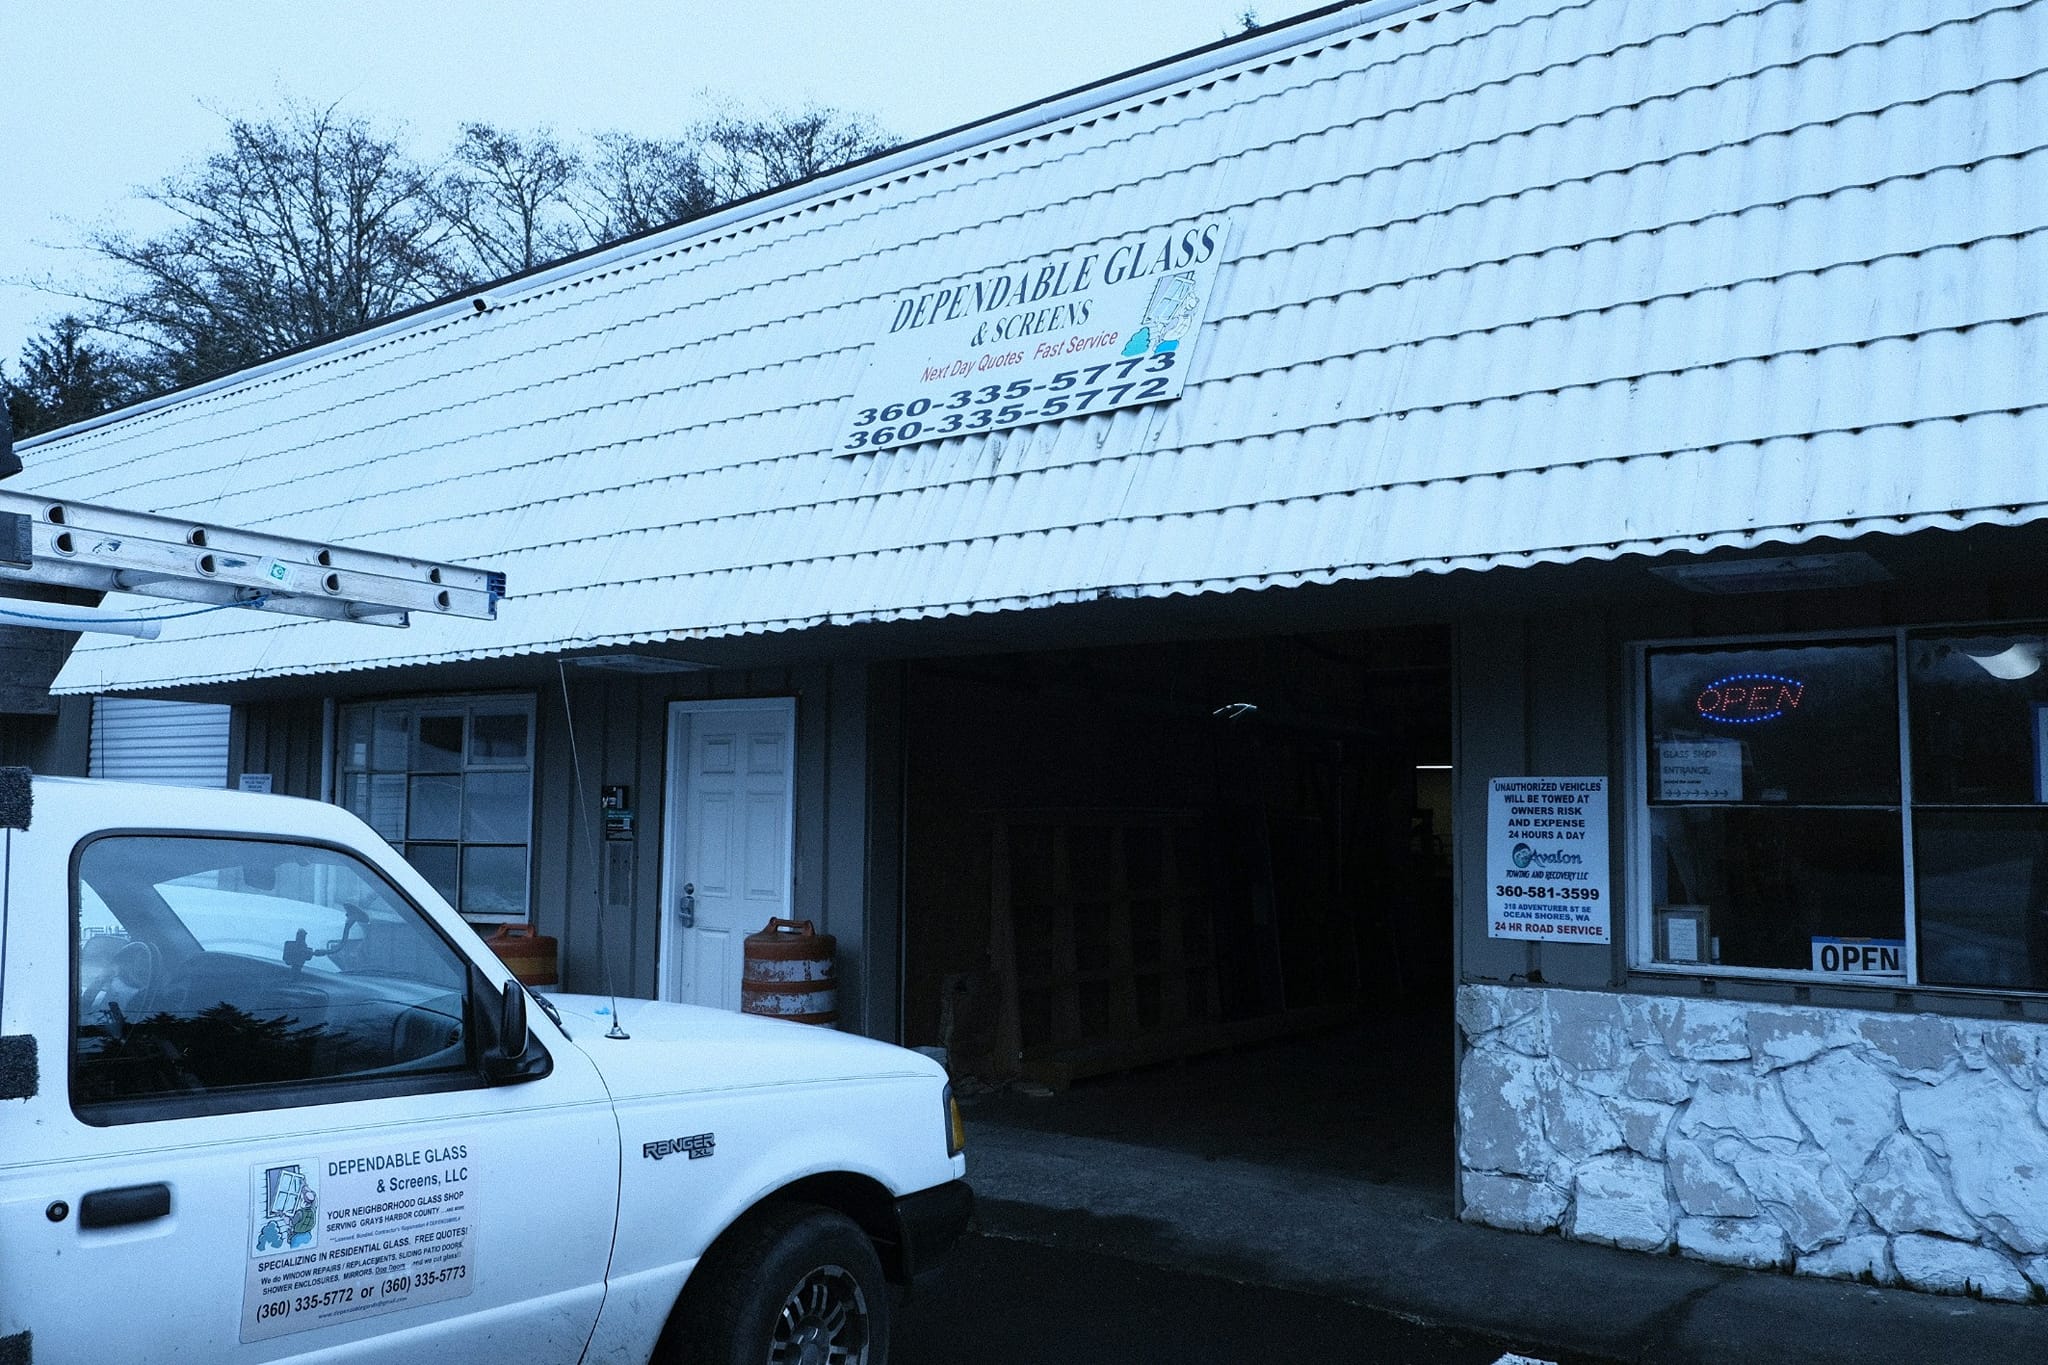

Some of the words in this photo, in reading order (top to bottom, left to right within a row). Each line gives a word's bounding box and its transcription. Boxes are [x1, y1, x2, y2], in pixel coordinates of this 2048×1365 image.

[889, 254, 1099, 335] DEPENDABLE
[1104, 223, 1220, 285] GLASS
[970, 321, 988, 348] &
[991, 299, 1094, 343] SCREENS
[920, 363, 951, 384] Next
[950, 360, 976, 379] Day
[978, 350, 1025, 372] Quotes
[1033, 338, 1066, 361] Fast
[1066, 330, 1119, 353] Service
[853, 351, 1176, 427] 360-335-5773
[843, 377, 1170, 450] 360-335-5772
[1697, 685, 1804, 712] OPEN
[1663, 750, 1689, 759] GLASS
[1692, 750, 1718, 759] SHOP
[1495, 782, 1558, 792] UNAUTHORIZED
[1560, 782, 1602, 792] VEHICLES
[1504, 794, 1525, 804] WILL
[1527, 794, 1540, 804] BE
[1541, 794, 1575, 804] TOWED
[1577, 795, 1590, 804] AT
[1508, 818, 1531, 827] AND
[1534, 818, 1586, 828] EXPENSE
[1511, 806, 1555, 815] OWNERS
[1557, 807, 1583, 816] RISK
[1508, 830, 1519, 839] 24
[1521, 830, 1555, 839] HOURS
[1556, 831, 1564, 840] A
[1566, 831, 1586, 840] DAY
[1530, 849, 1583, 868] Avalon
[1506, 869, 1530, 879] TOWING
[1531, 871, 1545, 880] AND
[1545, 871, 1576, 881] RECOVERY
[1576, 872, 1590, 881] LLC
[1496, 885, 1600, 900] 360-581-3599
[1503, 911, 1532, 919] OCEAN
[1534, 912, 1574, 921] SHORES,
[1576, 914, 1591, 922] WA
[1518, 903, 1568, 912] ADVENTURER
[1495, 922, 1506, 931] 24
[1509, 922, 1522, 932] HR
[1525, 923, 1555, 933] ROAD
[1556, 925, 1603, 936] SERVICE
[1820, 944, 1900, 971] OPEN
[328, 1151, 421, 1177] DEPENDABLE
[424, 1144, 468, 1163] GLASS
[376, 1178, 386, 1193] &
[389, 1174, 441, 1192] Screens,
[445, 1167, 468, 1183] LLC
[327, 1208, 351, 1220] YOUR
[351, 1198, 416, 1217] NEIGHBORHOOD
[417, 1194, 442, 1206] GLASS
[443, 1190, 464, 1202] SHOP
[326, 1220, 357, 1232] SERVING
[359, 1216, 384, 1227] GRAYS
[384, 1210, 412, 1223] HARBOR
[413, 1207, 440, 1218] COUNTY
[258, 1254, 317, 1273] SPECIALIZING
[318, 1252, 328, 1262] IN
[329, 1243, 382, 1260] RESIDENTIAL
[414, 1232, 435, 1244] FREE
[435, 1226, 468, 1241] QUOTES!
[261, 1277, 272, 1286] We
[272, 1275, 282, 1284] do
[282, 1269, 312, 1282] WINDOW
[312, 1263, 341, 1276] REPAIRS
[398, 1248, 422, 1260] SLIDING
[423, 1245, 441, 1255] PATIO
[256, 1299, 291, 1324] (360)
[294, 1287, 354, 1313] 335-5772
[360, 1285, 375, 1299] or
[381, 1275, 411, 1298] (360)
[414, 1264, 467, 1288] 335-5773
[262, 1283, 293, 1296] SHOWER
